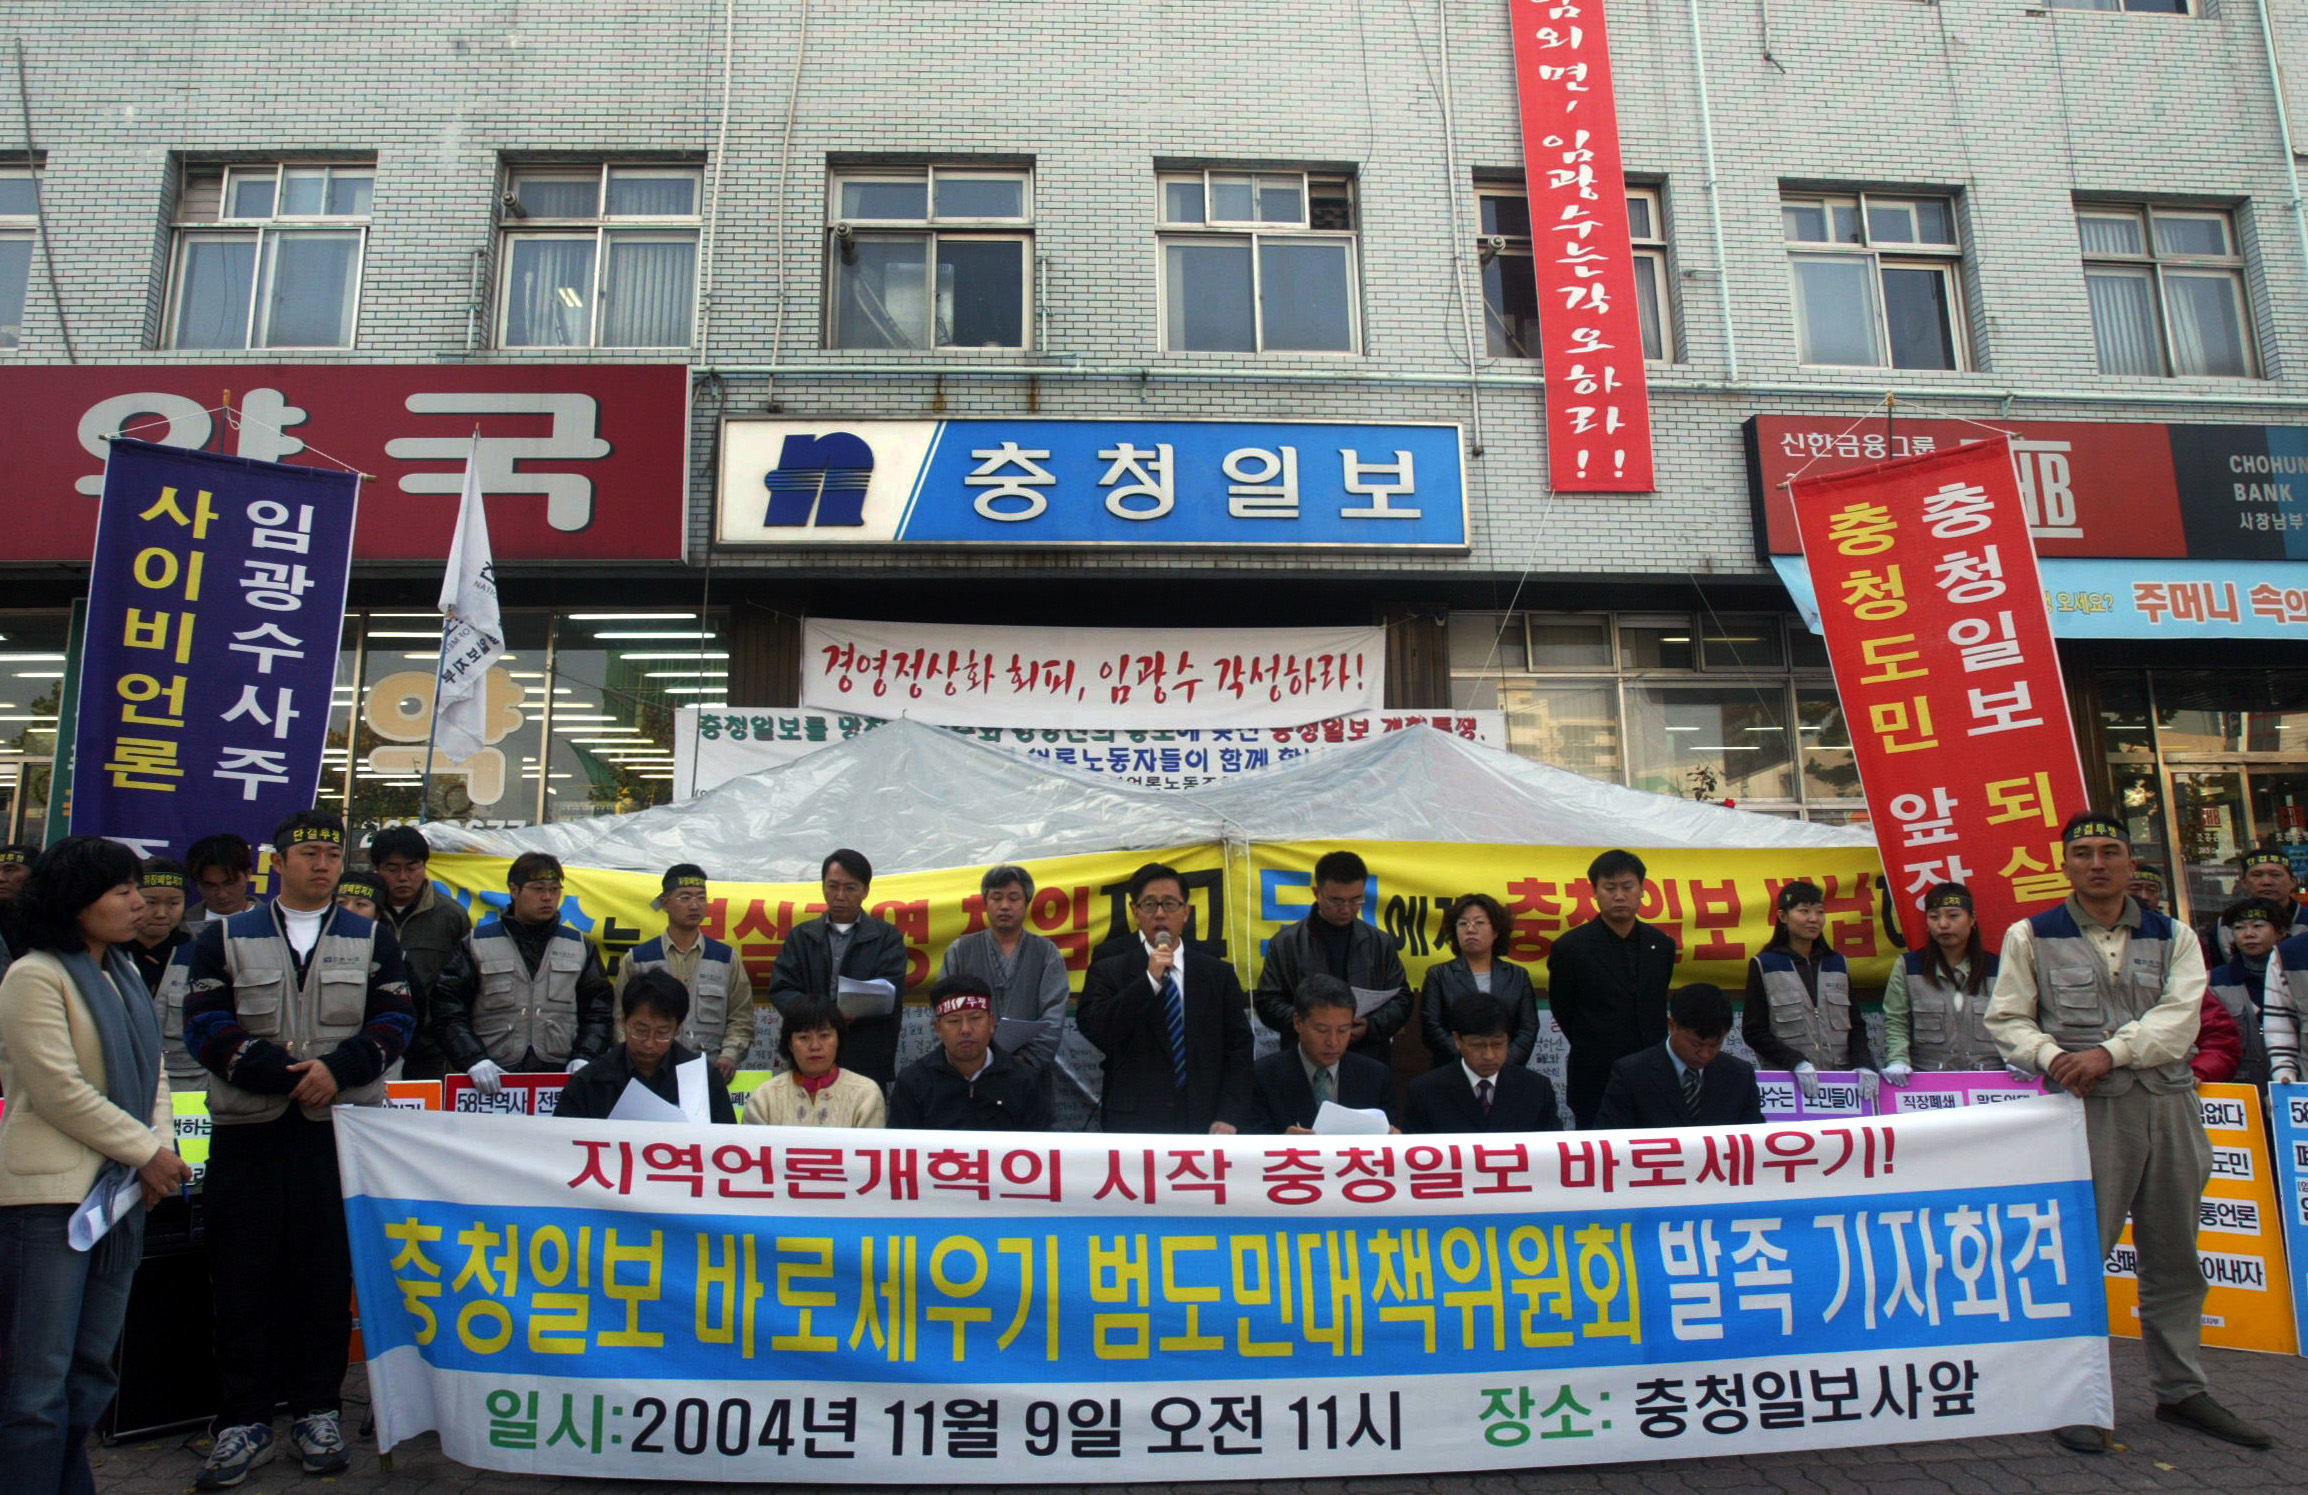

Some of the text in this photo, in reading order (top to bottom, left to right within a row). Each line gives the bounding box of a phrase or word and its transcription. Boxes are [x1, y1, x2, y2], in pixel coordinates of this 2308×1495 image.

[964, 441, 1423, 522] 충청일보
[2229, 454, 2308, 474] CHOHUN
[2233, 482, 2294, 502] BANK
[2240, 512, 2308, 531] 사창남부
[1828, 501, 1939, 755] 충청도민
[1921, 481, 2044, 737] 충청일보
[2056, 591, 2114, 614] 오세요?
[2132, 582, 2240, 624] 주머니
[822, 643, 1365, 706] 경영정상화 회피, 임광수 각성하라!
[700, 714, 828, 741] 충청일보를
[567, 1126, 1897, 1206] 지역언론개혁의 시작 충청일보 바로세우기!
[384, 1198, 2072, 1363] 충청일보 바로세우기 범도민대책위원회 발족 기자회견
[882, 1399, 999, 1460] 11월
[1024, 1397, 1122, 1460] 9일
[1147, 1394, 1263, 1457] 오전
[1288, 1390, 1402, 1453] 11시
[1478, 1383, 1612, 1449] 장소:
[1635, 1358, 1980, 1440] 충청일보사앞
